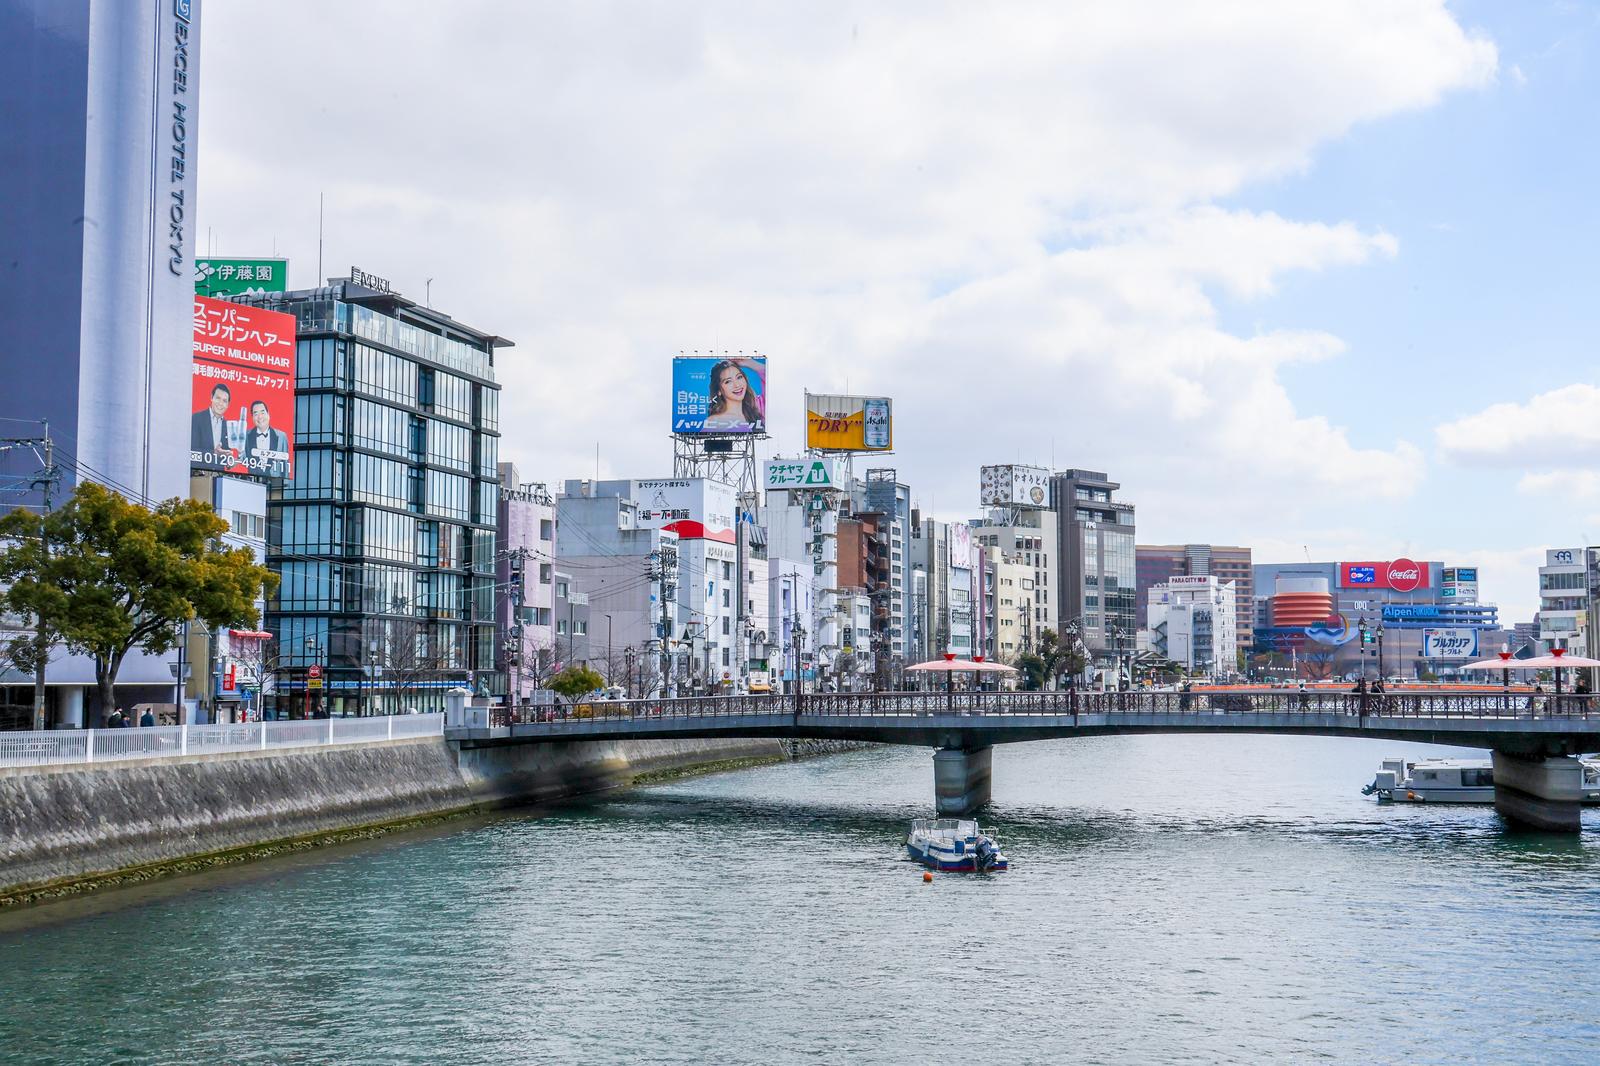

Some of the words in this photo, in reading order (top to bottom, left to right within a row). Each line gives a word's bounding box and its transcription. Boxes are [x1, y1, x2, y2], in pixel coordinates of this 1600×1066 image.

[173, 21, 188, 95] EXCEL
[171, 101, 187, 184] HOTEL
[168, 189, 185, 277] TOKYU
[216, 264, 273, 281] 伊藤園
[193, 302, 251, 325] スーパー
[193, 318, 291, 347] ミリオンヘアー
[192, 341, 225, 356] SUPER
[228, 348, 265, 364] MILLION
[267, 355, 290, 368] HAIR
[677, 404, 706, 415] 出会う
[675, 419, 764, 429] ハッピーメール
[866, 416, 887, 425] Asahi
[204, 452, 291, 473] 0120-494-111
[769, 464, 804, 474] ウチヤマ
[769, 475, 804, 485] グループ
[642, 509, 690, 520] 福一不動産
[1389, 569, 1418, 580] Coca-Cola
[1384, 607, 1412, 617] Alpen
[1412, 607, 1440, 616] FUKUOKA
[1432, 636, 1471, 648] ブルガリア
